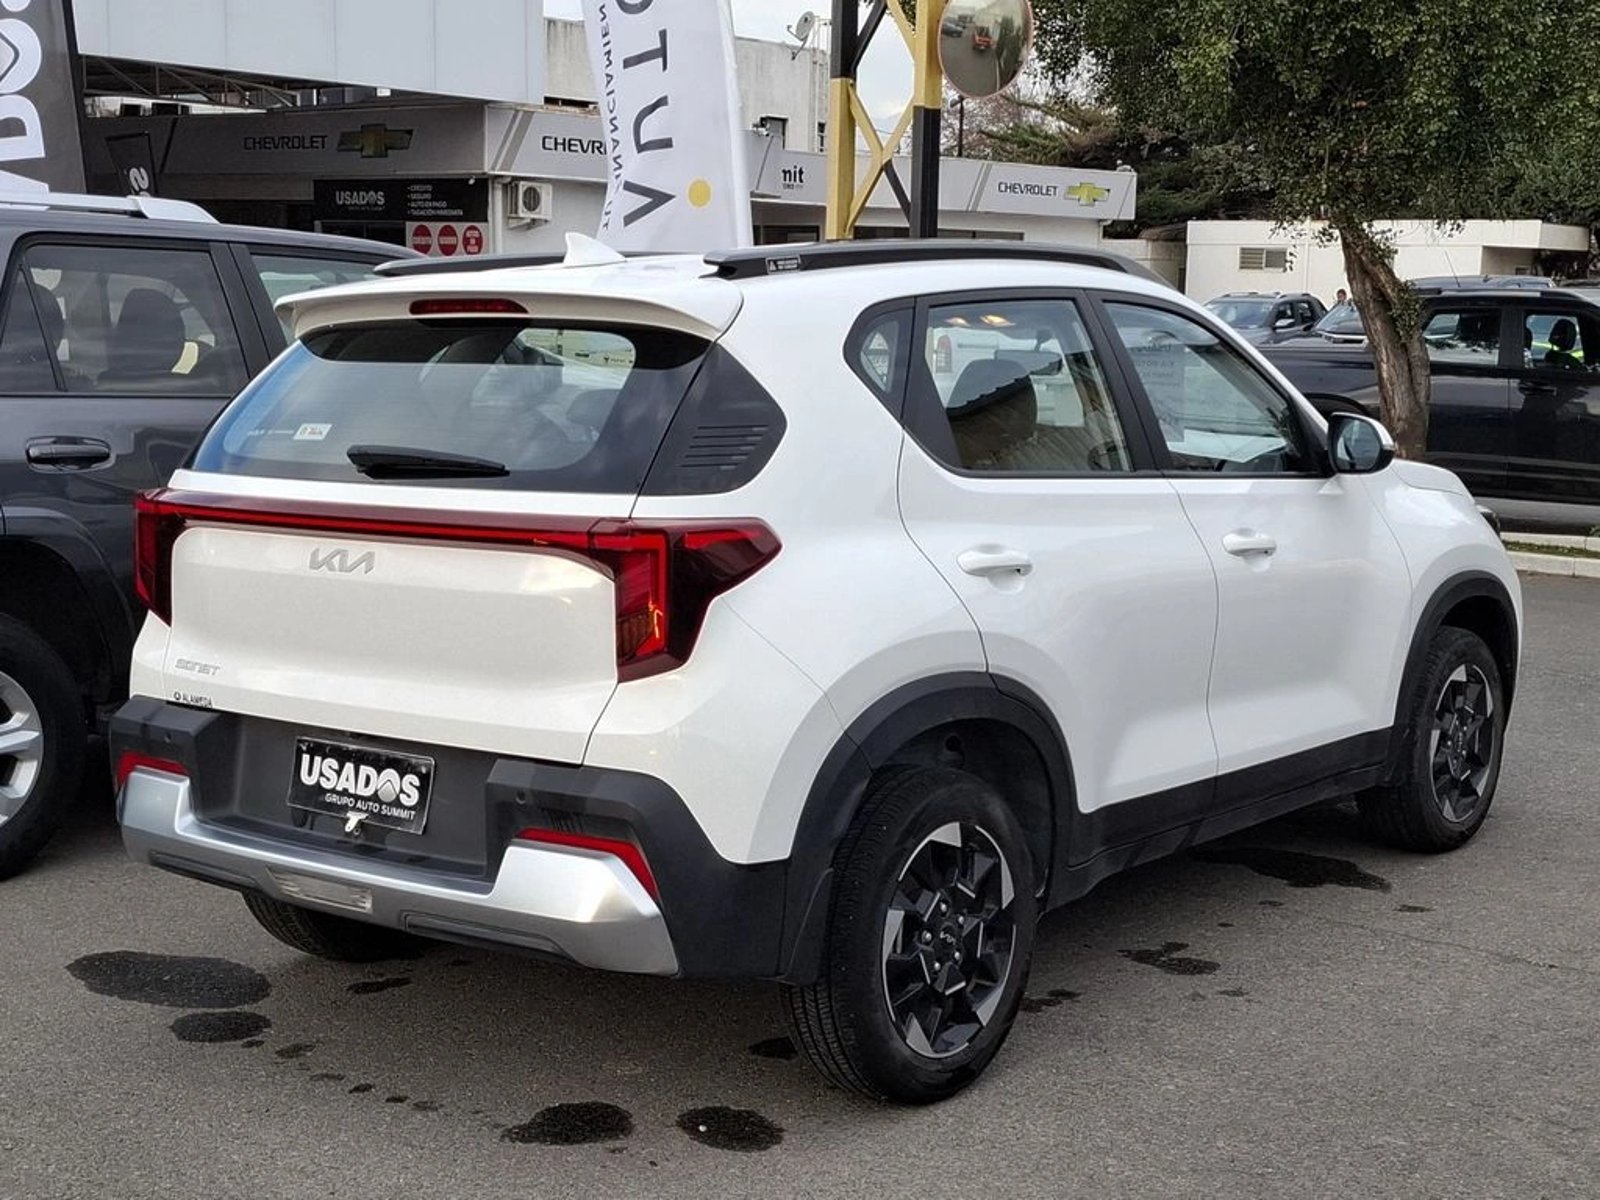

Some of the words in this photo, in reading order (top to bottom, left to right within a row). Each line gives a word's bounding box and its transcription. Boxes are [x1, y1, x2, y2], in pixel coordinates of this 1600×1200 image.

[243, 135, 328, 150] CHEVROLET
[542, 135, 607, 155] CHEVR
[335, 190, 386, 205] USADOS
[998, 181, 1058, 196] CHEVROLET
[309, 548, 376, 575] KIA
[300, 753, 421, 807] USADOS
[324, 792, 356, 807] GRUPO
[355, 799, 380, 813] AUTO
[380, 804, 417, 821] SUMMIT
